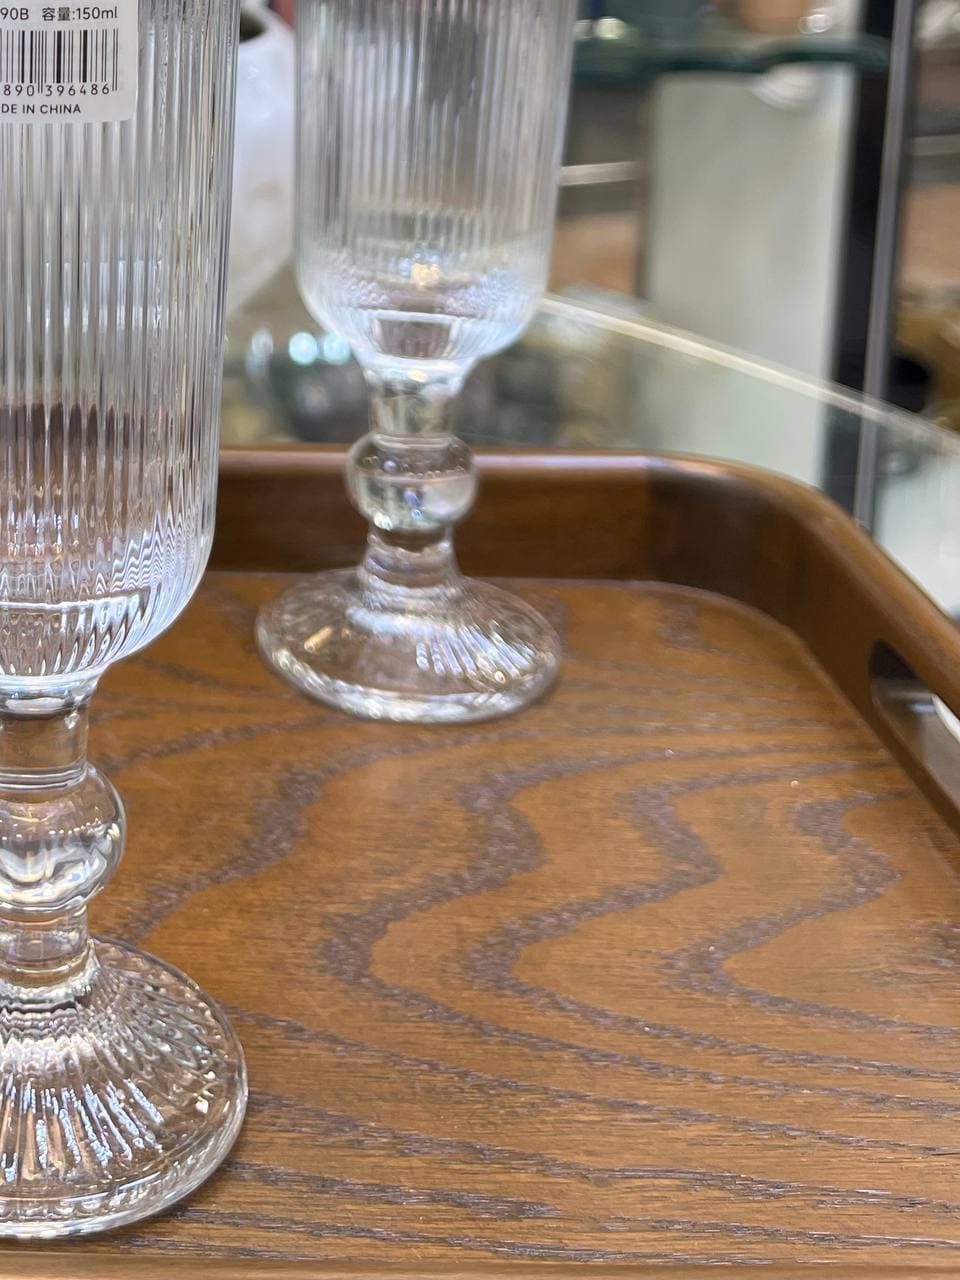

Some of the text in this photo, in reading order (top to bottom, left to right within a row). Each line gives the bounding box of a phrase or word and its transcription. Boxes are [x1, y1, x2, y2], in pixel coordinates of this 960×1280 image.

[41, 6, 119, 22] 容量:150ml
[22, 103, 36, 115] IN
[39, 103, 82, 115] CHINA
